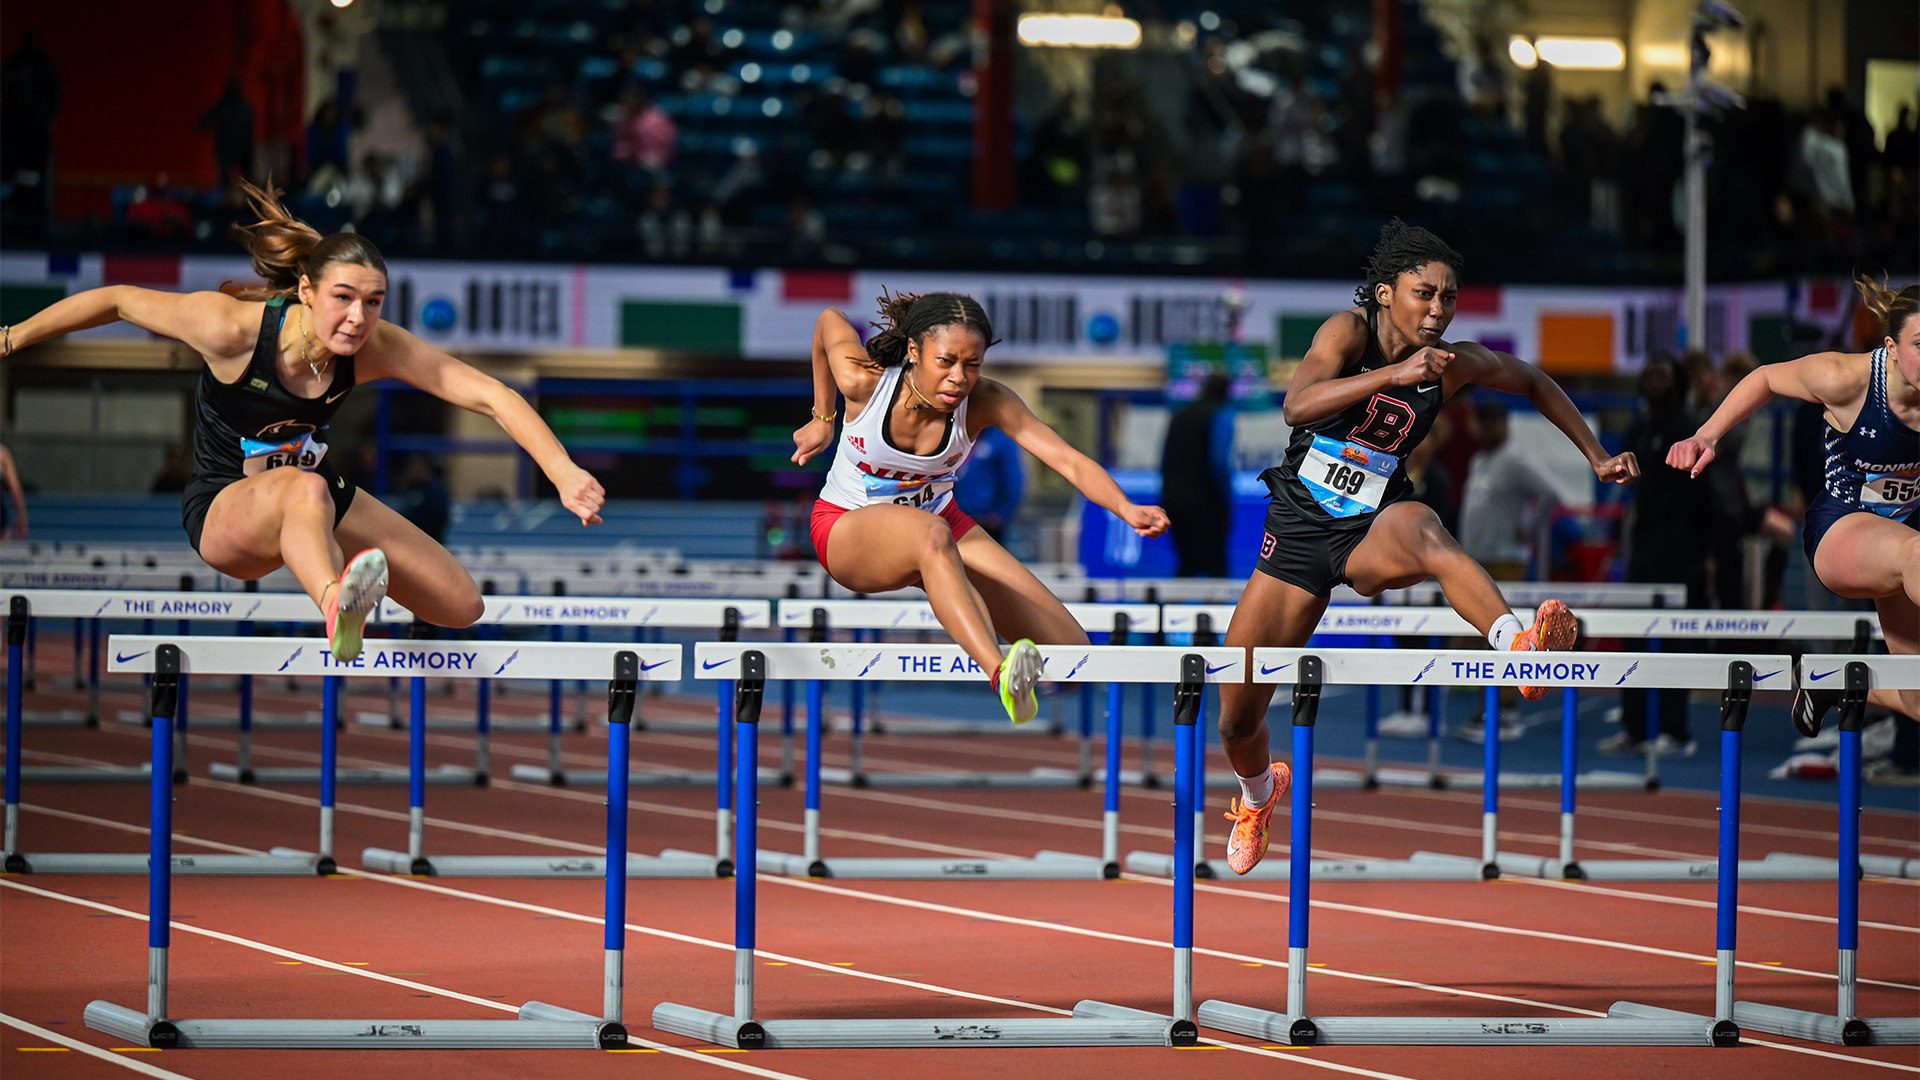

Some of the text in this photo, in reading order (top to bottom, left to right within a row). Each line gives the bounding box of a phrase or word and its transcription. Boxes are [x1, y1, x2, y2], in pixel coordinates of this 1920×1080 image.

[1346, 393, 1416, 452] B
[267, 450, 317, 471] 649
[1323, 462, 1366, 496] 169
[1260, 531, 1278, 559] B
[123, 599, 233, 615] THE ARMORY
[523, 605, 631, 620] THE ARMORY
[1335, 616, 1403, 630] ARMORY
[1670, 618, 1770, 633] THE ARMORY
[373, 651, 478, 670] ARMORY
[898, 656, 942, 673] THE
[1451, 661, 1600, 681] THE ARMORY
